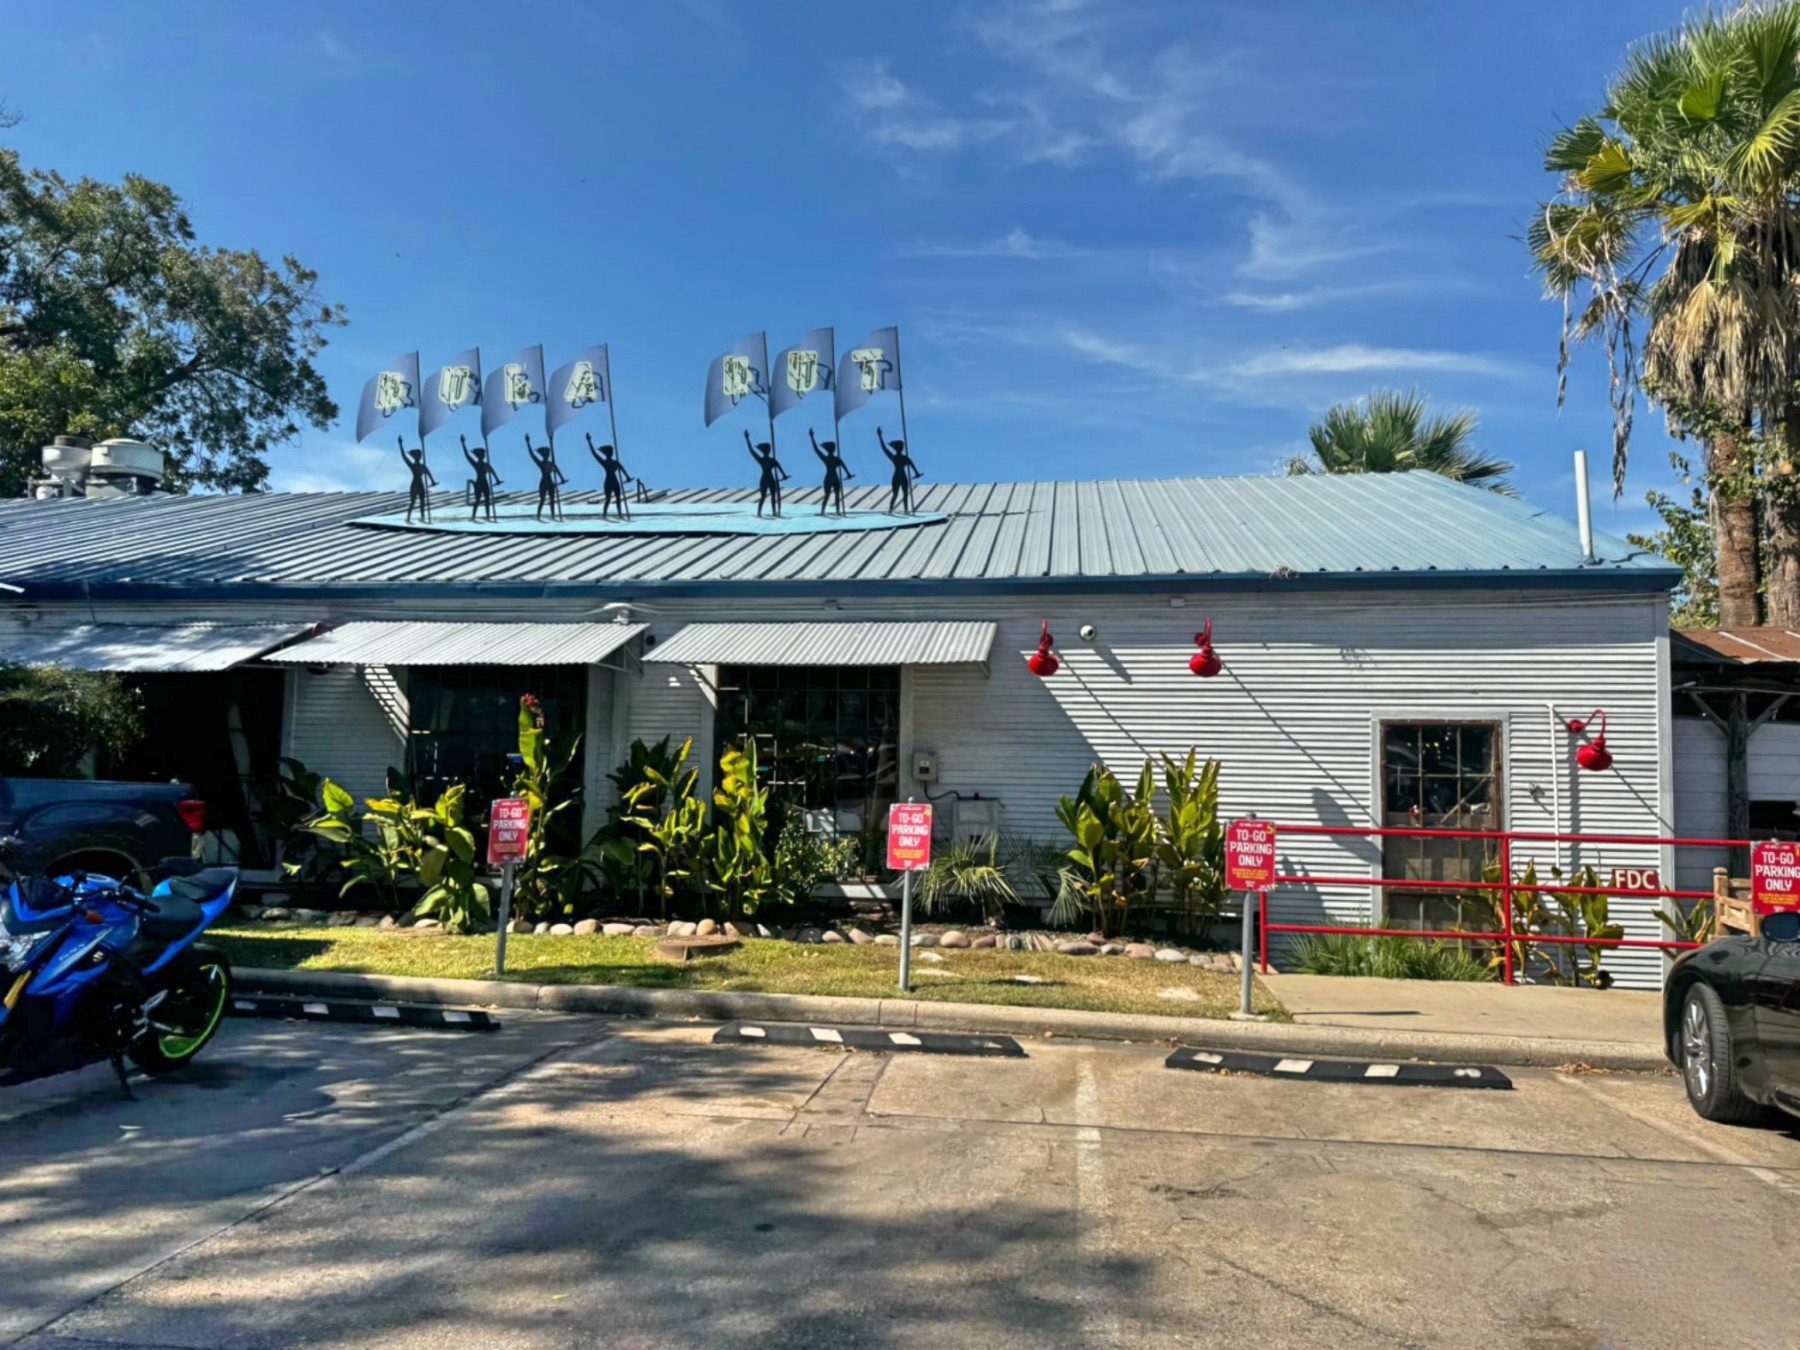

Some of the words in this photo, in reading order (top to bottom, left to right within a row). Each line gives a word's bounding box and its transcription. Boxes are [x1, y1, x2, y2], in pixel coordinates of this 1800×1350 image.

[499, 807, 522, 818] TO-GO
[898, 813, 924, 824] TO-GO
[493, 820, 526, 830] PARKING
[892, 824, 928, 836] PARKING
[498, 830, 518, 841] ONLY
[899, 836, 920, 847] ONLY
[1236, 829, 1267, 842] TO-GO
[1229, 842, 1273, 855] PARKING
[1238, 854, 1263, 867] ONLY
[1761, 851, 1794, 865] TO-GO
[1754, 864, 1800, 879] PARKING
[1615, 869, 1656, 890] FDC
[1765, 878, 1793, 892] ONLY
